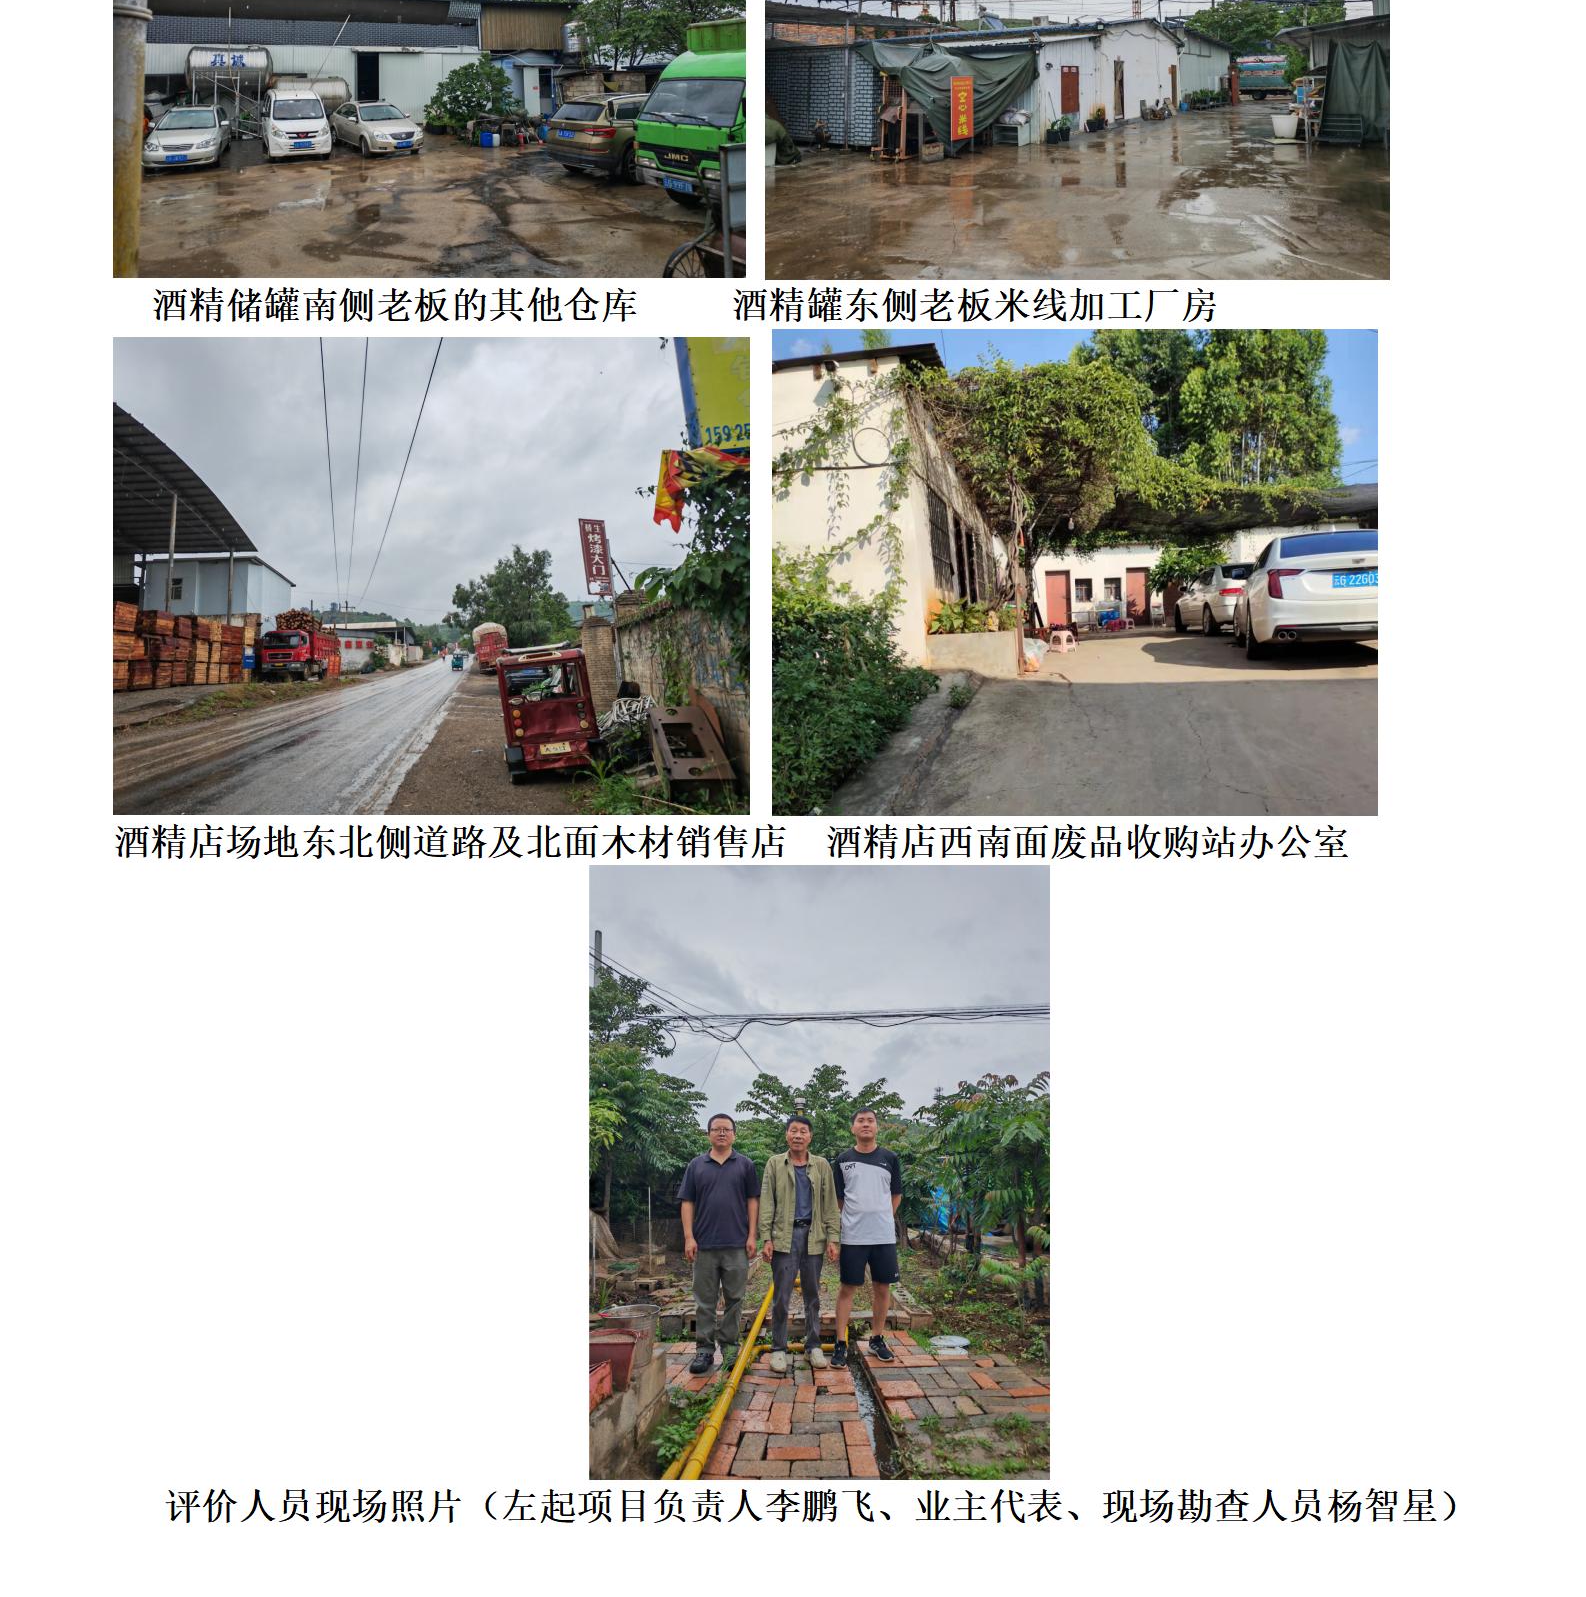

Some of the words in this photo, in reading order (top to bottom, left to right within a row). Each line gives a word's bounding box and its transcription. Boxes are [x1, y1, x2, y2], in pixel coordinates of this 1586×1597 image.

[664, 152, 689, 162] JMC
[153, 287, 637, 322] 酒精储罐南侧老板的其他仓库
[733, 287, 1217, 322] 酒精罐东侧老板米线加工厂房
[587, 533, 606, 576] 烤漆大门
[115, 824, 786, 859] 酒精店场地东北侧道路及北面木材销售店
[825, 824, 1349, 859] 酒精店西南面废品收购站办公室
[165, 1488, 1457, 1523] 评价人员现场照片（左起项目负责人李鹏飞、业主代表、现场勘查人员杨智星）
